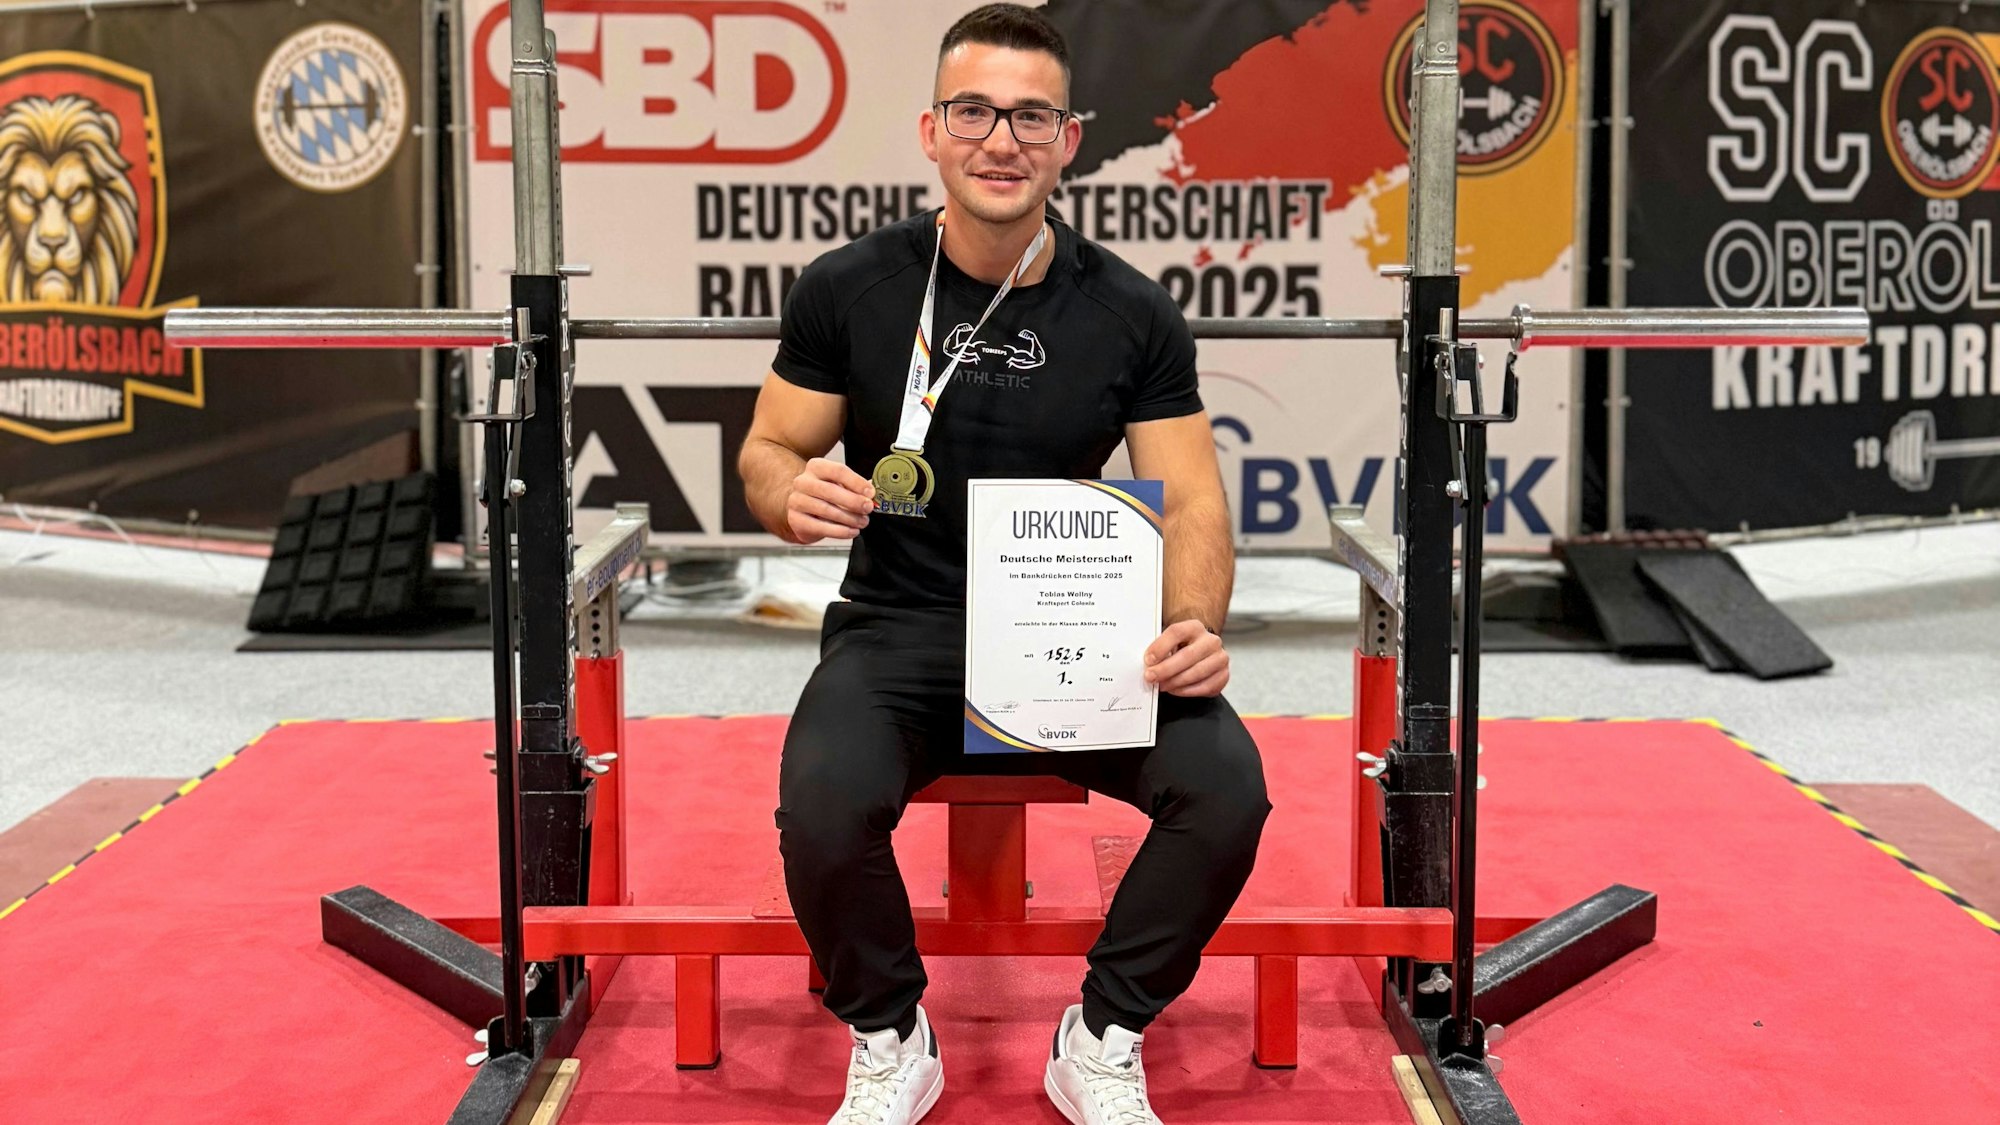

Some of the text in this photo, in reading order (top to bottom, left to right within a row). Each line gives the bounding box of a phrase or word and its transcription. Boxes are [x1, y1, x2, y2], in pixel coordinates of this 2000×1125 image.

[486, 1, 846, 150] SBD TM
[1919, 50, 1974, 112] SC
[1708, 15, 1872, 201] SC
[697, 184, 1327, 241] DEUTSCHE TERSCHAFT
[1705, 199, 2000, 314] OBERÖL
[1160, 265, 1321, 317] 2025
[953, 368, 1031, 389] ATHLETIC
[1854, 437, 1881, 468] 19
[881, 500, 929, 518] BVDK
[1241, 458, 1556, 534] BVK
[1012, 511, 1119, 539] URKUNDE
[1000, 555, 1133, 563] Deutsche Meisterschaft
[1043, 647, 1086, 662] 152,5
[1057, 671, 1073, 686] 1.
[1046, 730, 1077, 739] BVDK
